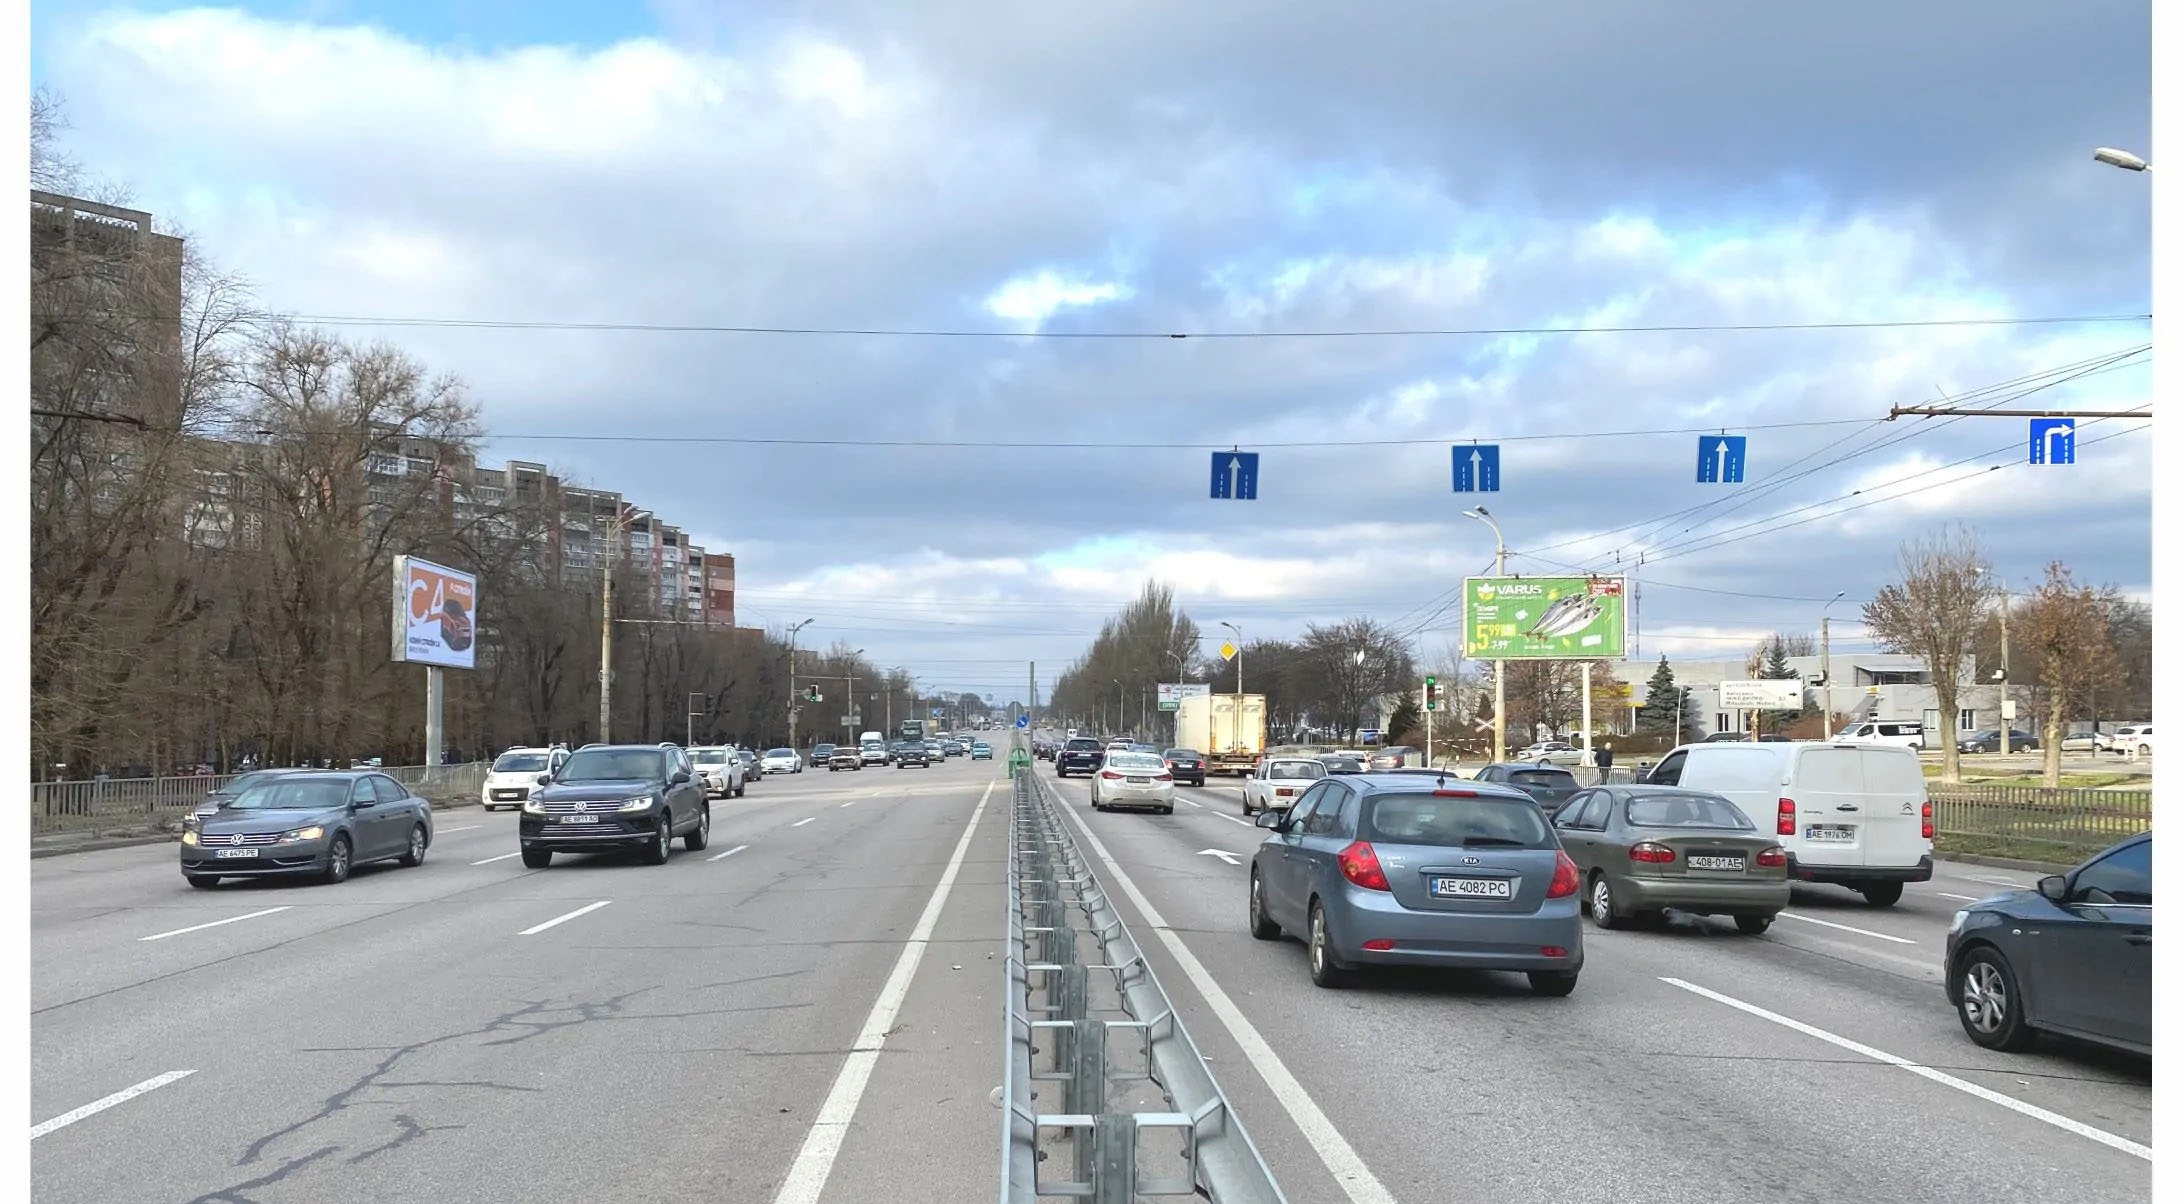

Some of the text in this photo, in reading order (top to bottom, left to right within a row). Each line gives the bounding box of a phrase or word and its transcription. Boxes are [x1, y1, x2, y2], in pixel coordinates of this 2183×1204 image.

[1497, 585, 1543, 595] VARUS
[1476, 624, 1489, 650] 5
[1812, 831, 1823, 839] AE
[1439, 880, 1506, 895] AE 4082 PC
